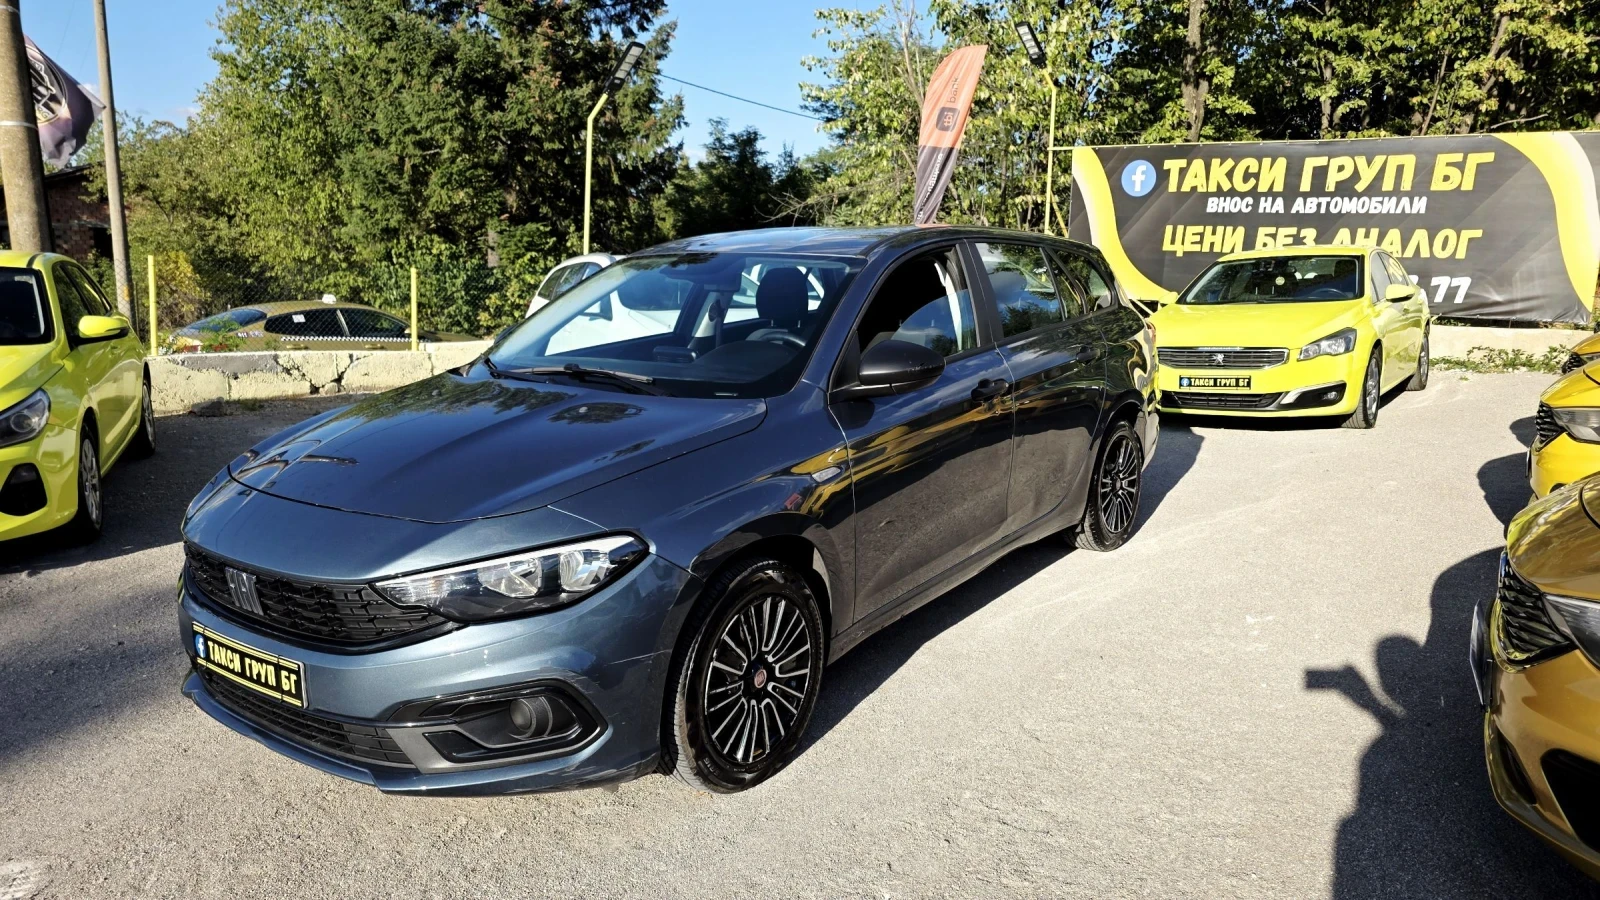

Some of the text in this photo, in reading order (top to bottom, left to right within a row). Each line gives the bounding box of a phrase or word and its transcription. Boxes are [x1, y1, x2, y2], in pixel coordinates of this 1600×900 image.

[947, 77, 959, 103] bank
[1163, 152, 1495, 193] ТАКСИ ГРУП БГ
[1206, 196, 1428, 214] ВНОС НА АВТОМОБИЛИ
[1162, 225, 1246, 257] ЦЕНИ
[1190, 378, 1249, 386] ТАКСИ ГРУП БГ
[207, 641, 298, 694] ТАКСИ ГРУП БГ
